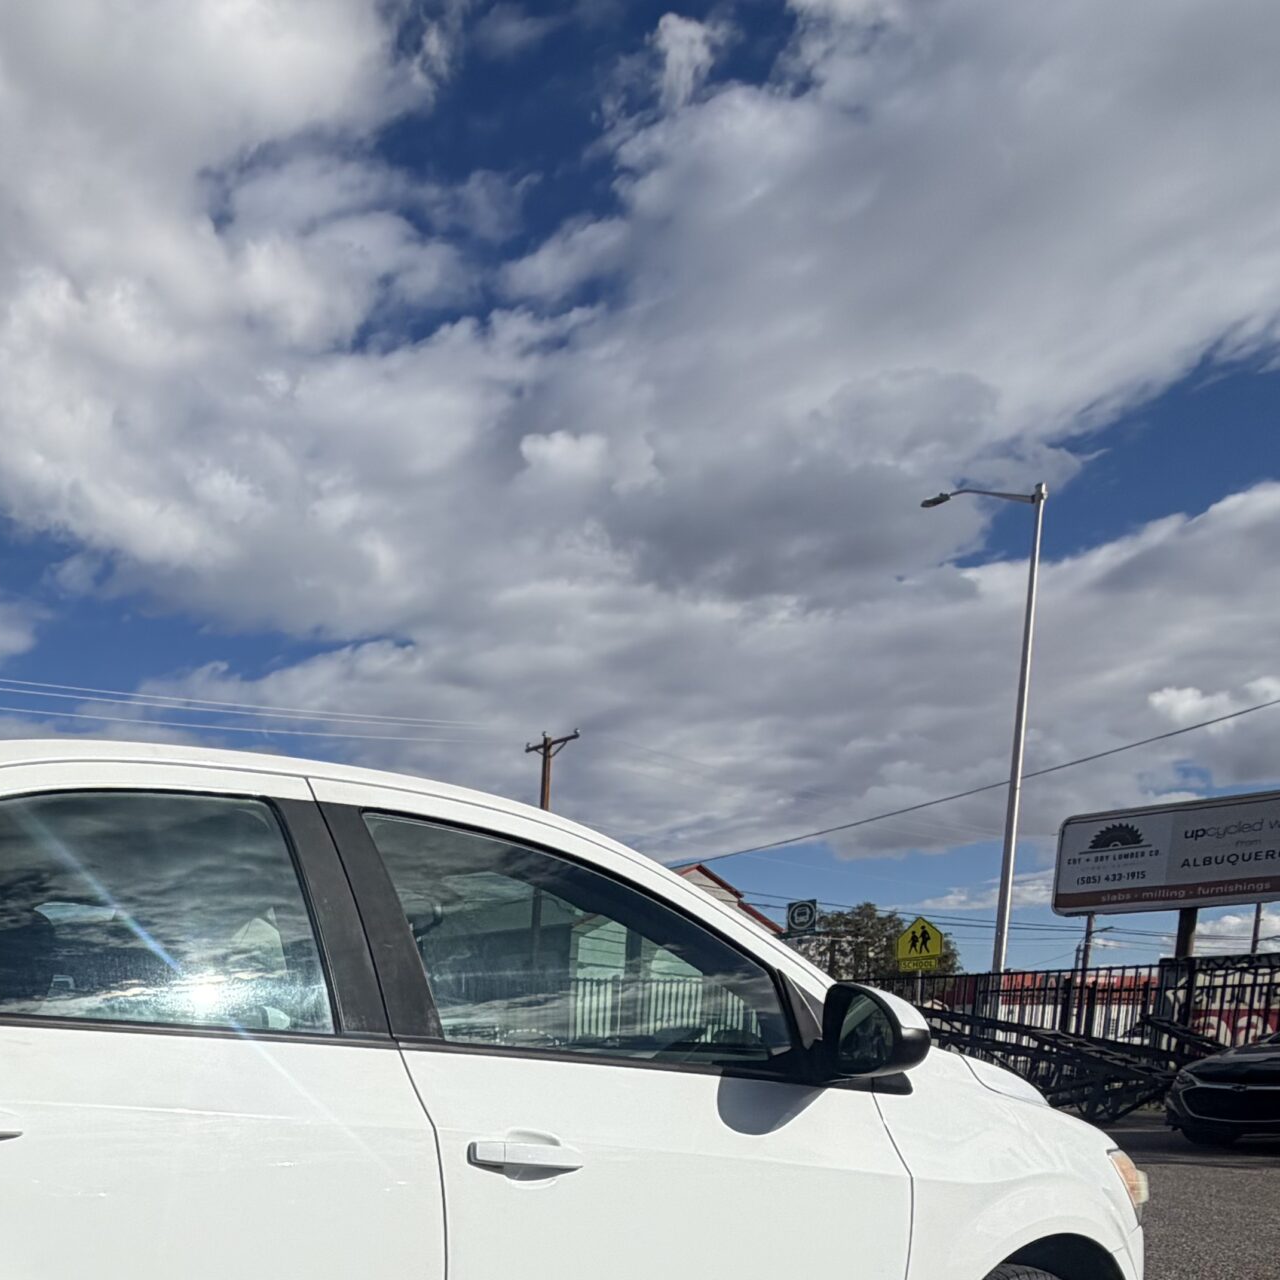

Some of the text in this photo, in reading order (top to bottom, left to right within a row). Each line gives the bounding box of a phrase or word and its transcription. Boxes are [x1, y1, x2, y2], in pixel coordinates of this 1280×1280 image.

[1184, 818, 1265, 841] upcycled
[1181, 849, 1280, 869] ALBUQUER
[1077, 875, 1101, 886] (505)
[1101, 881, 1271, 902] slabs milling furnishings
[902, 960, 934, 969] SCHOOL
